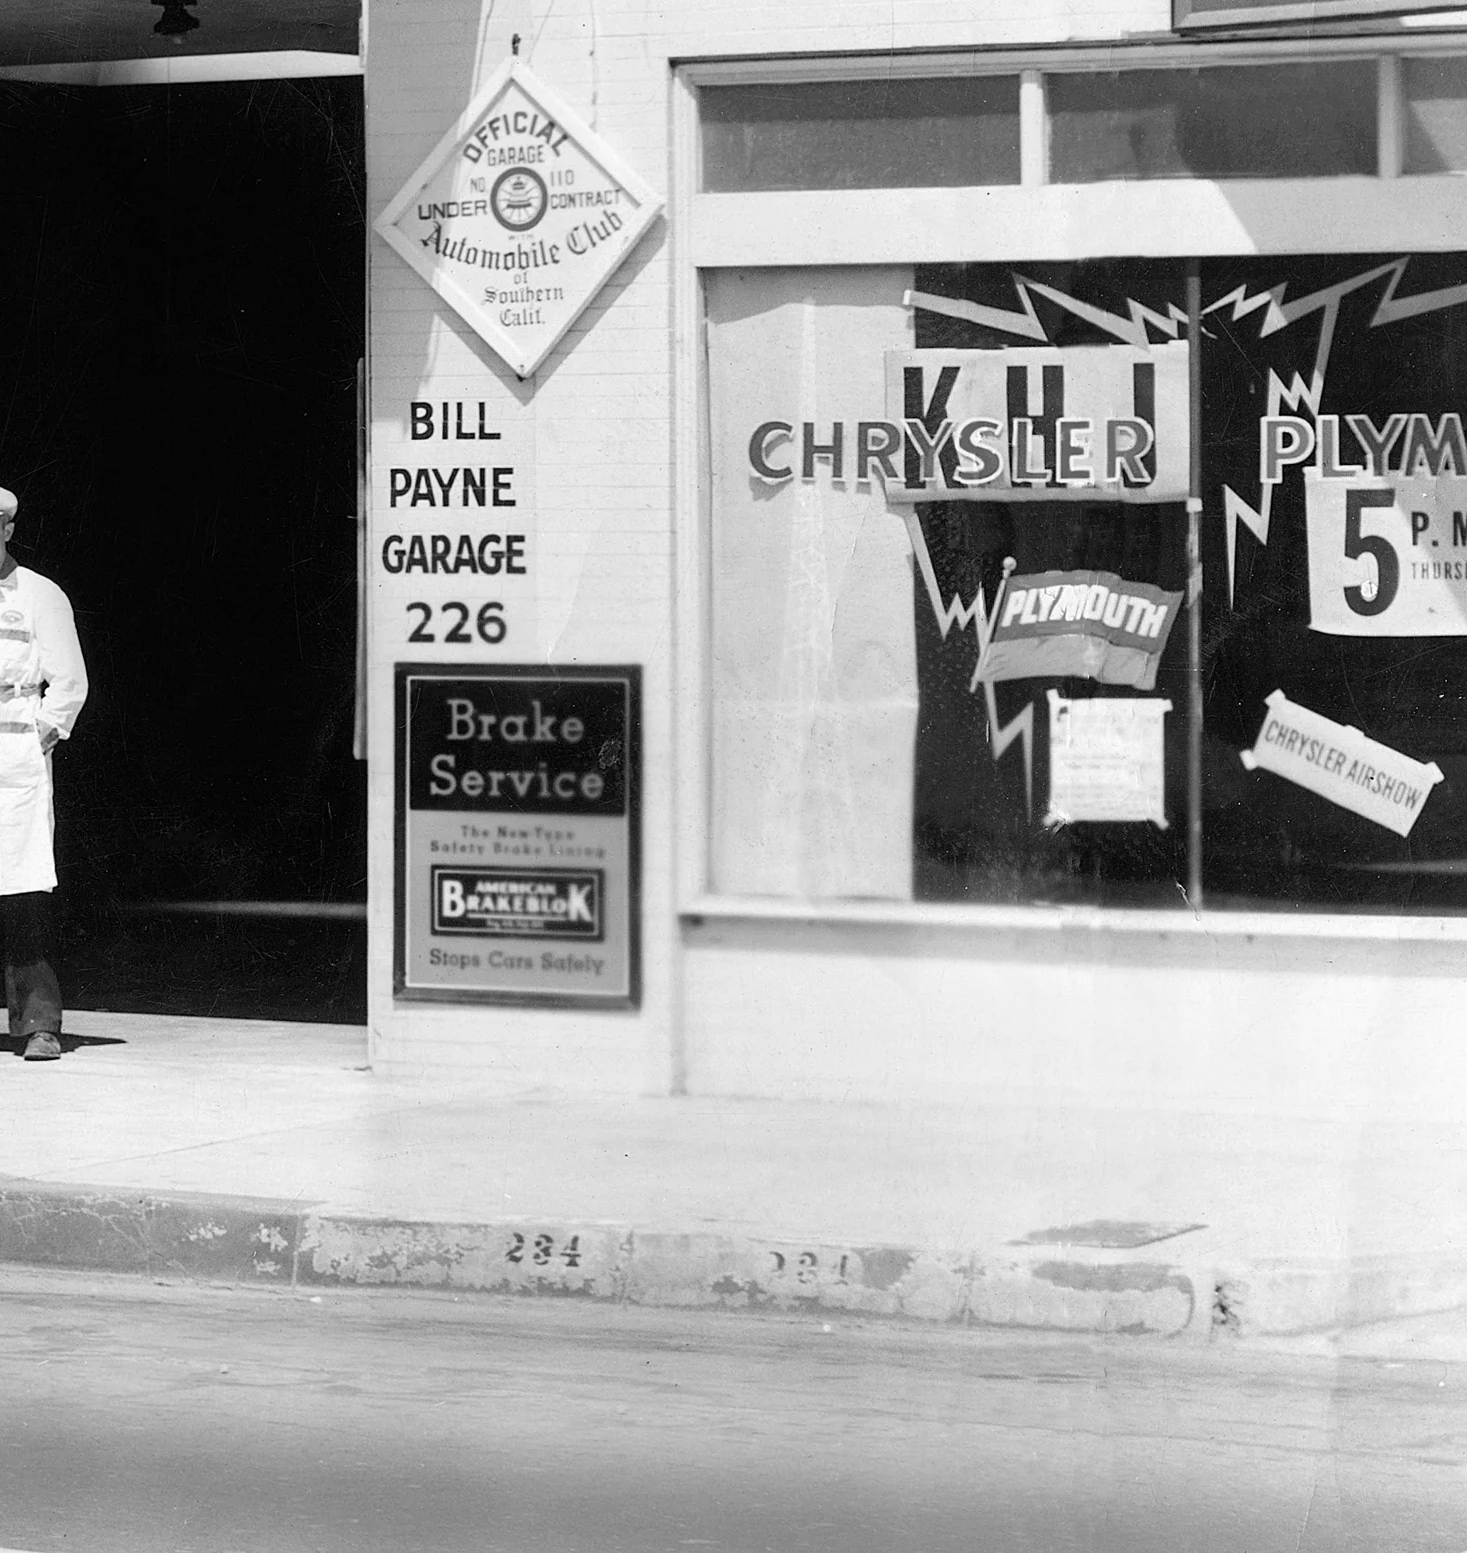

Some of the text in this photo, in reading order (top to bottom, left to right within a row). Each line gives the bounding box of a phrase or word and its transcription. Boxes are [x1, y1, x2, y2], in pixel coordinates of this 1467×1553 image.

[462, 111, 570, 165] OFFICIAL
[487, 144, 545, 167] GARAGE
[418, 189, 621, 221] UNDER CONTRACT
[420, 209, 624, 272] Automobile Club
[480, 286, 565, 306] Southern
[410, 401, 502, 441] BILL
[747, 416, 1156, 485] CHRYSLER
[1260, 412, 1467, 484] PLYM
[389, 467, 517, 508] PAYNE
[381, 533, 527, 575] GARAGE
[1343, 488, 1400, 617] 5
[1411, 560, 1467, 580] THURS
[405, 601, 508, 645] 226
[1000, 583, 1168, 638] PLYMOUTH
[446, 698, 585, 743] Brake
[429, 753, 605, 799] Service
[1264, 719, 1423, 810] CHRYSLER AIRSHOW
[430, 839, 485, 856] Safety
[493, 841, 542, 856] Brake
[461, 824, 575, 841] The New Type
[474, 881, 557, 896] AMERICAN
[429, 947, 606, 977] Stops Cars Safely
